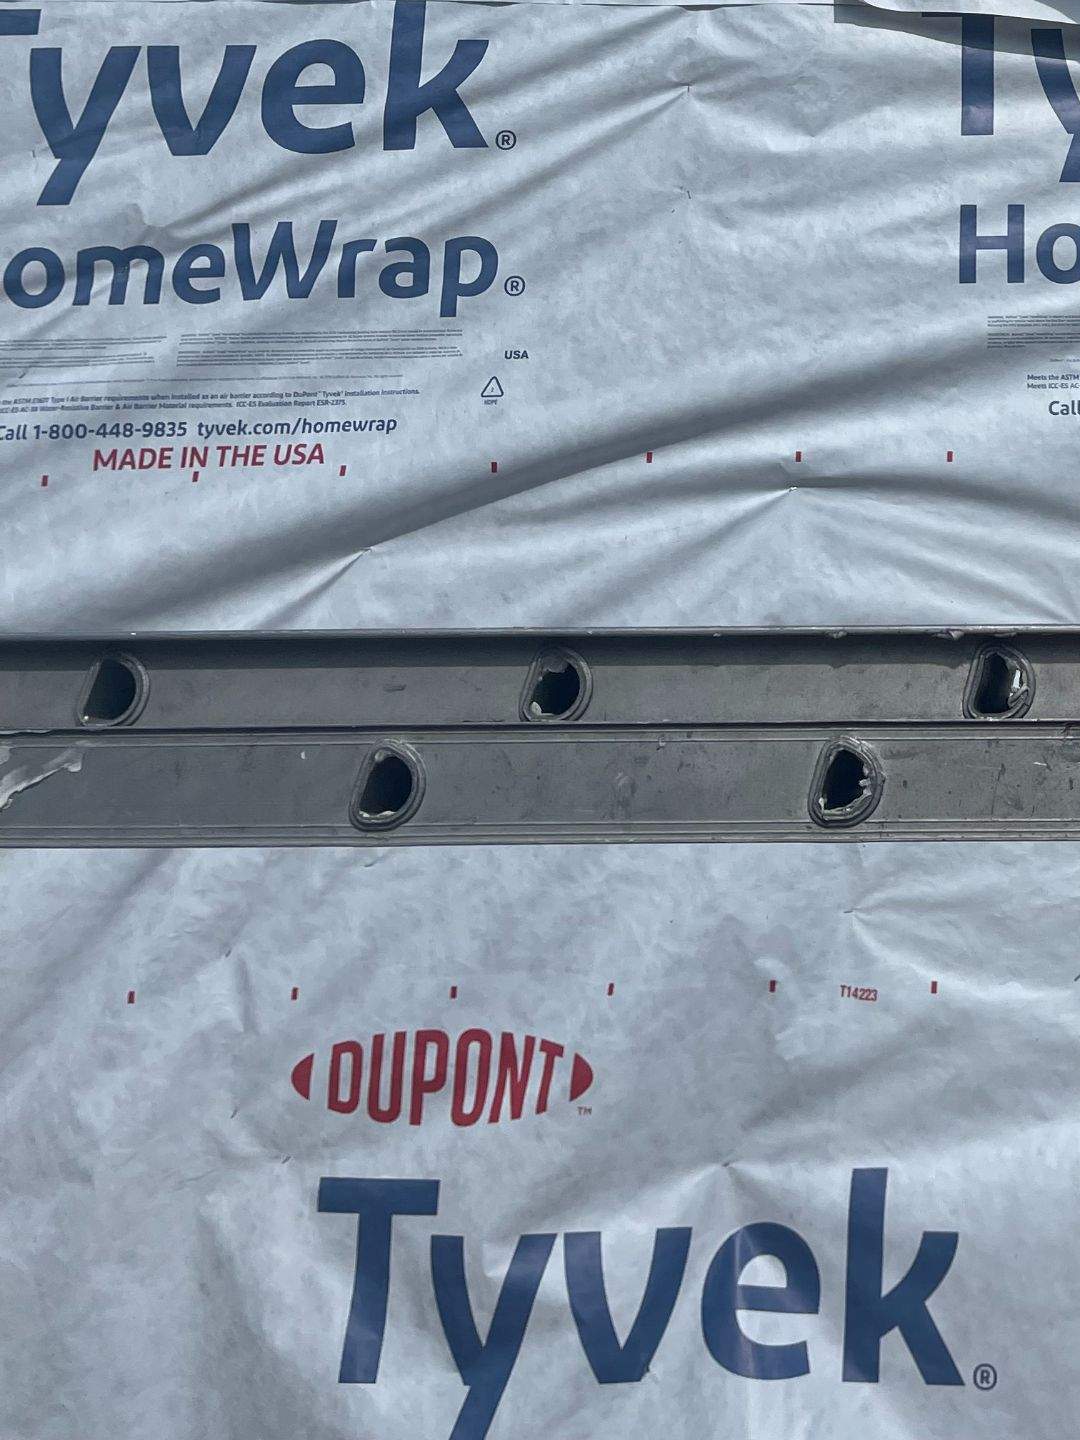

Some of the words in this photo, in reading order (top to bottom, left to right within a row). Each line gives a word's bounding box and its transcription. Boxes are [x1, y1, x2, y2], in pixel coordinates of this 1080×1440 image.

[504, 350, 529, 360] USA
[33, 422, 187, 440] 1-800-448-9835
[197, 418, 397, 439] tyvek.com/homewrap
[92, 446, 173, 472] MADE
[180, 445, 209, 469] IN
[216, 445, 267, 468] THE
[273, 443, 325, 465] USA
[840, 984, 878, 1001] T14223
[327, 1028, 565, 1127] DUPONT
